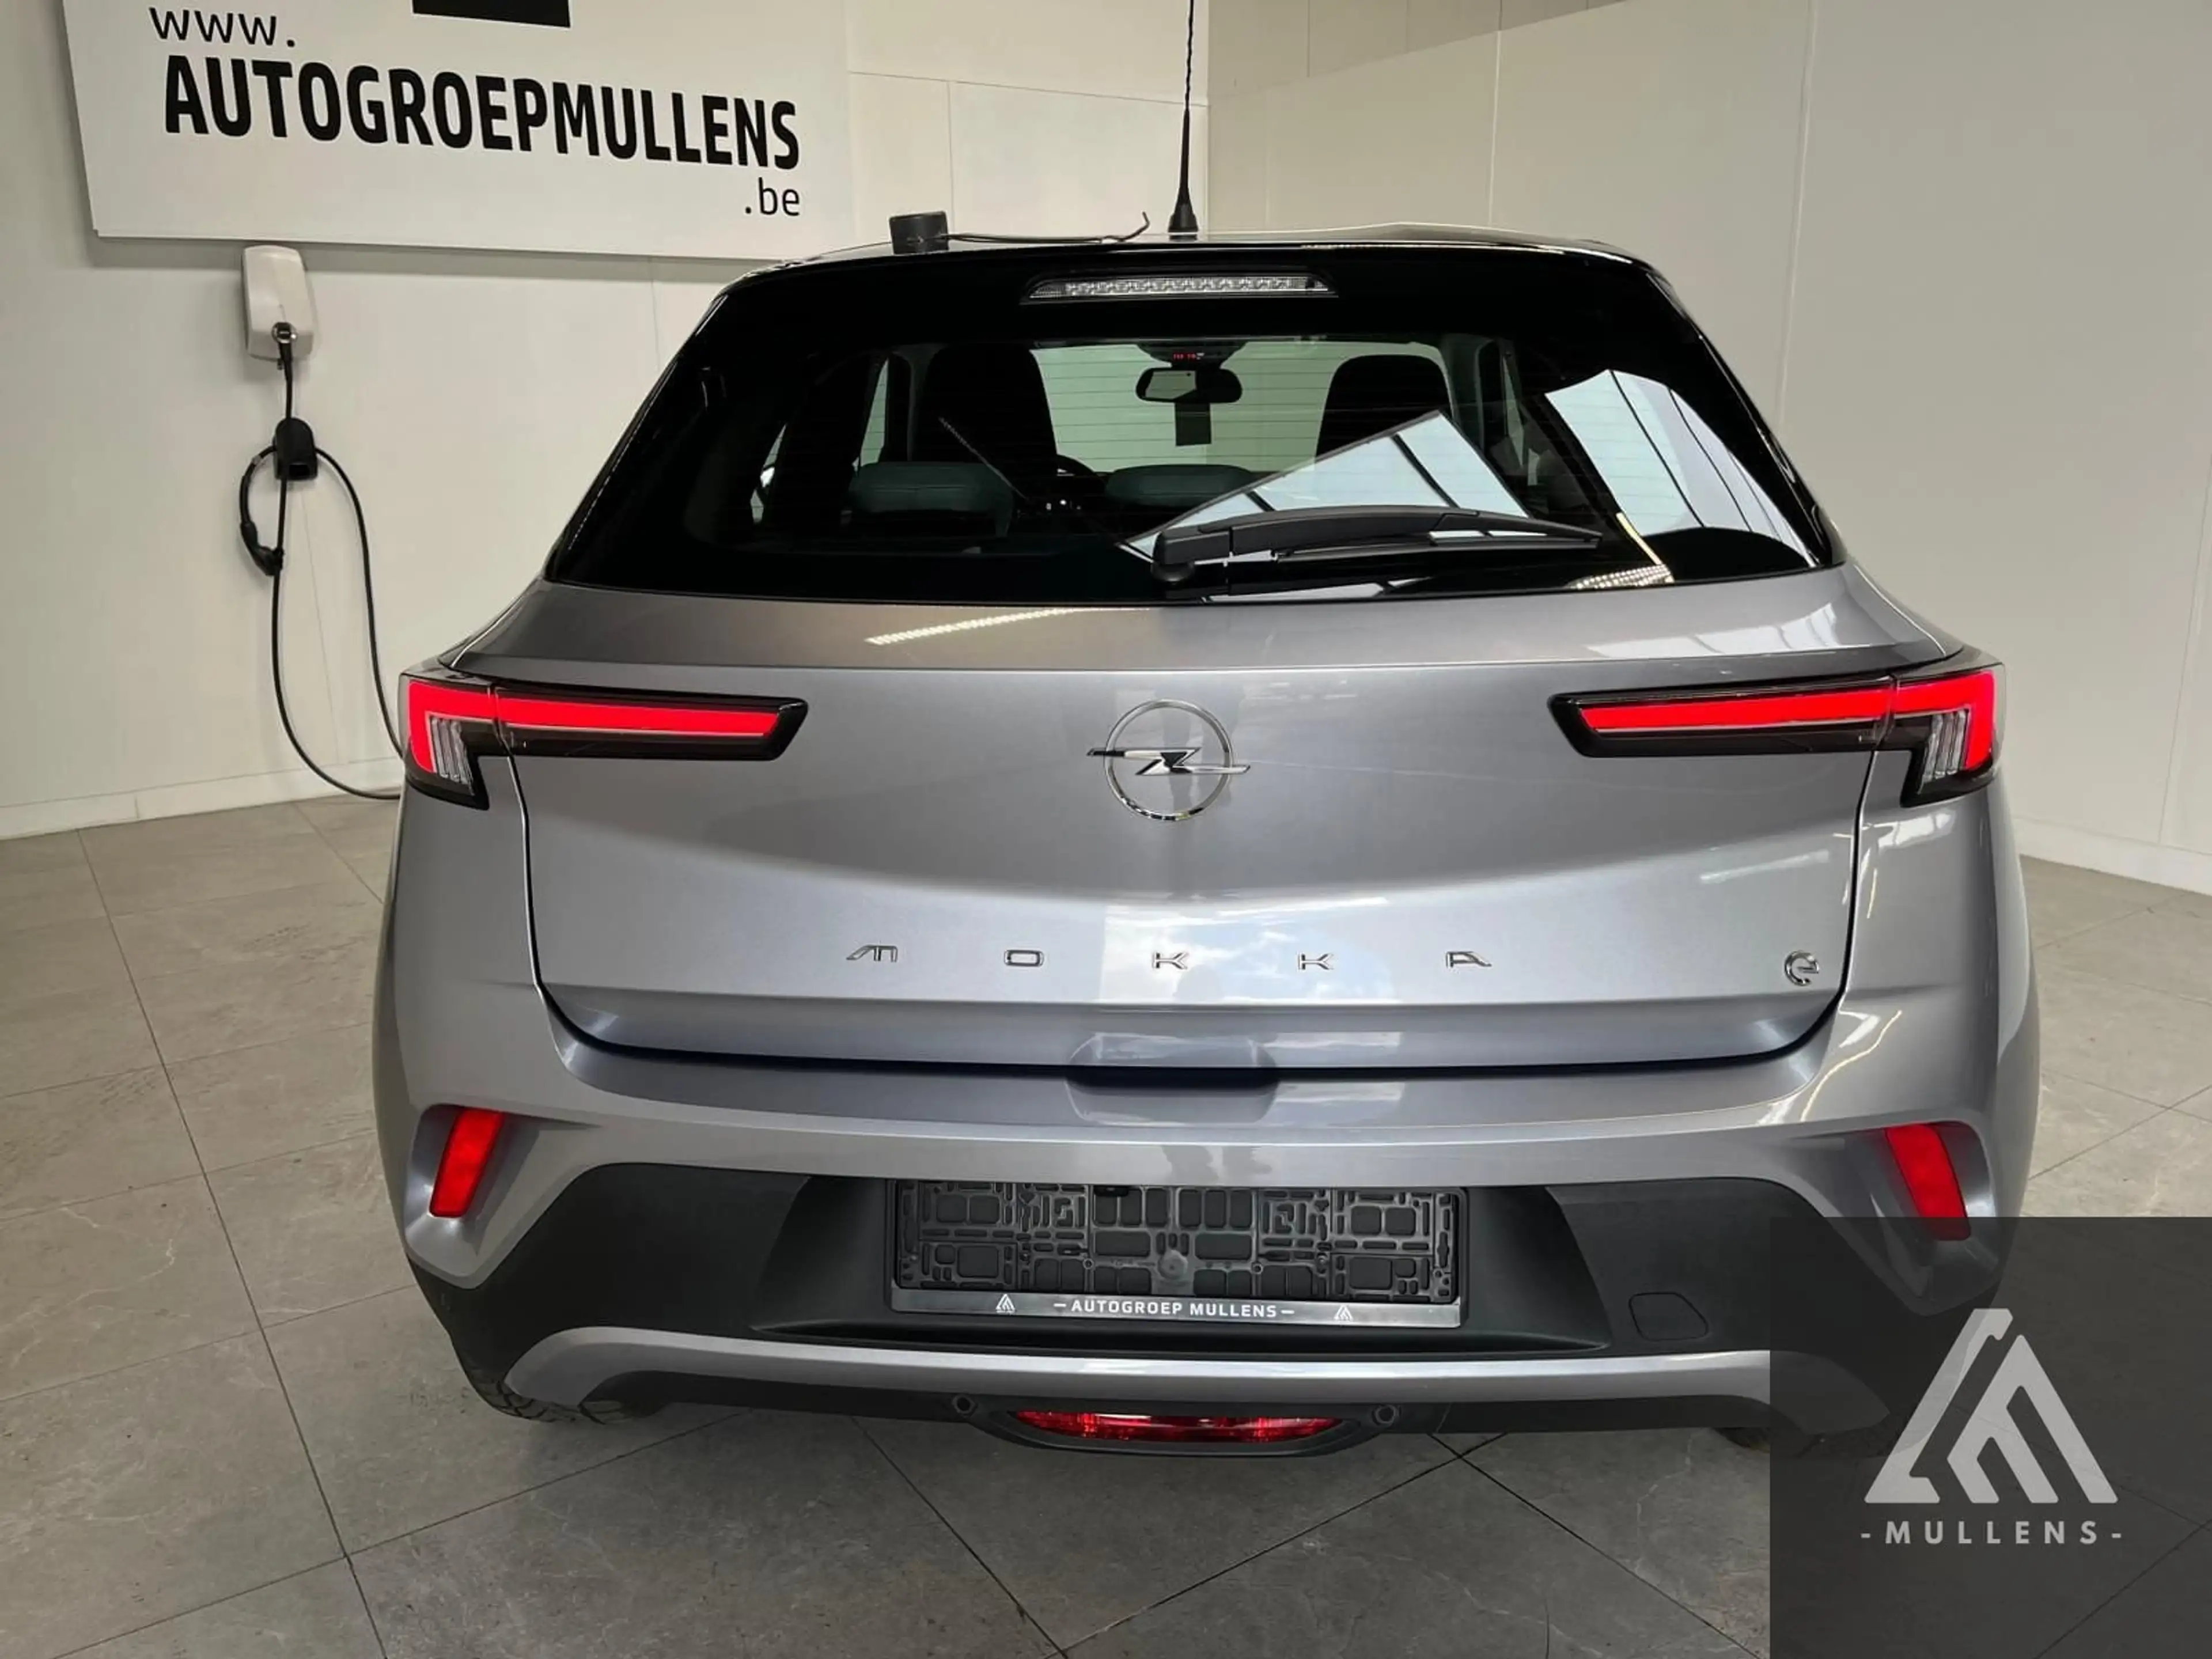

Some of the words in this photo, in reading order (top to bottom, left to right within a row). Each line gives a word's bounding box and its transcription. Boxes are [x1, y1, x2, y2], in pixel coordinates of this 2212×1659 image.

[150, 7, 296, 47] www.
[165, 55, 800, 169] AUTOGROEPMULLENS
[745, 177, 800, 216] .be
[1070, 1300, 1183, 1316] AUTOGROEP
